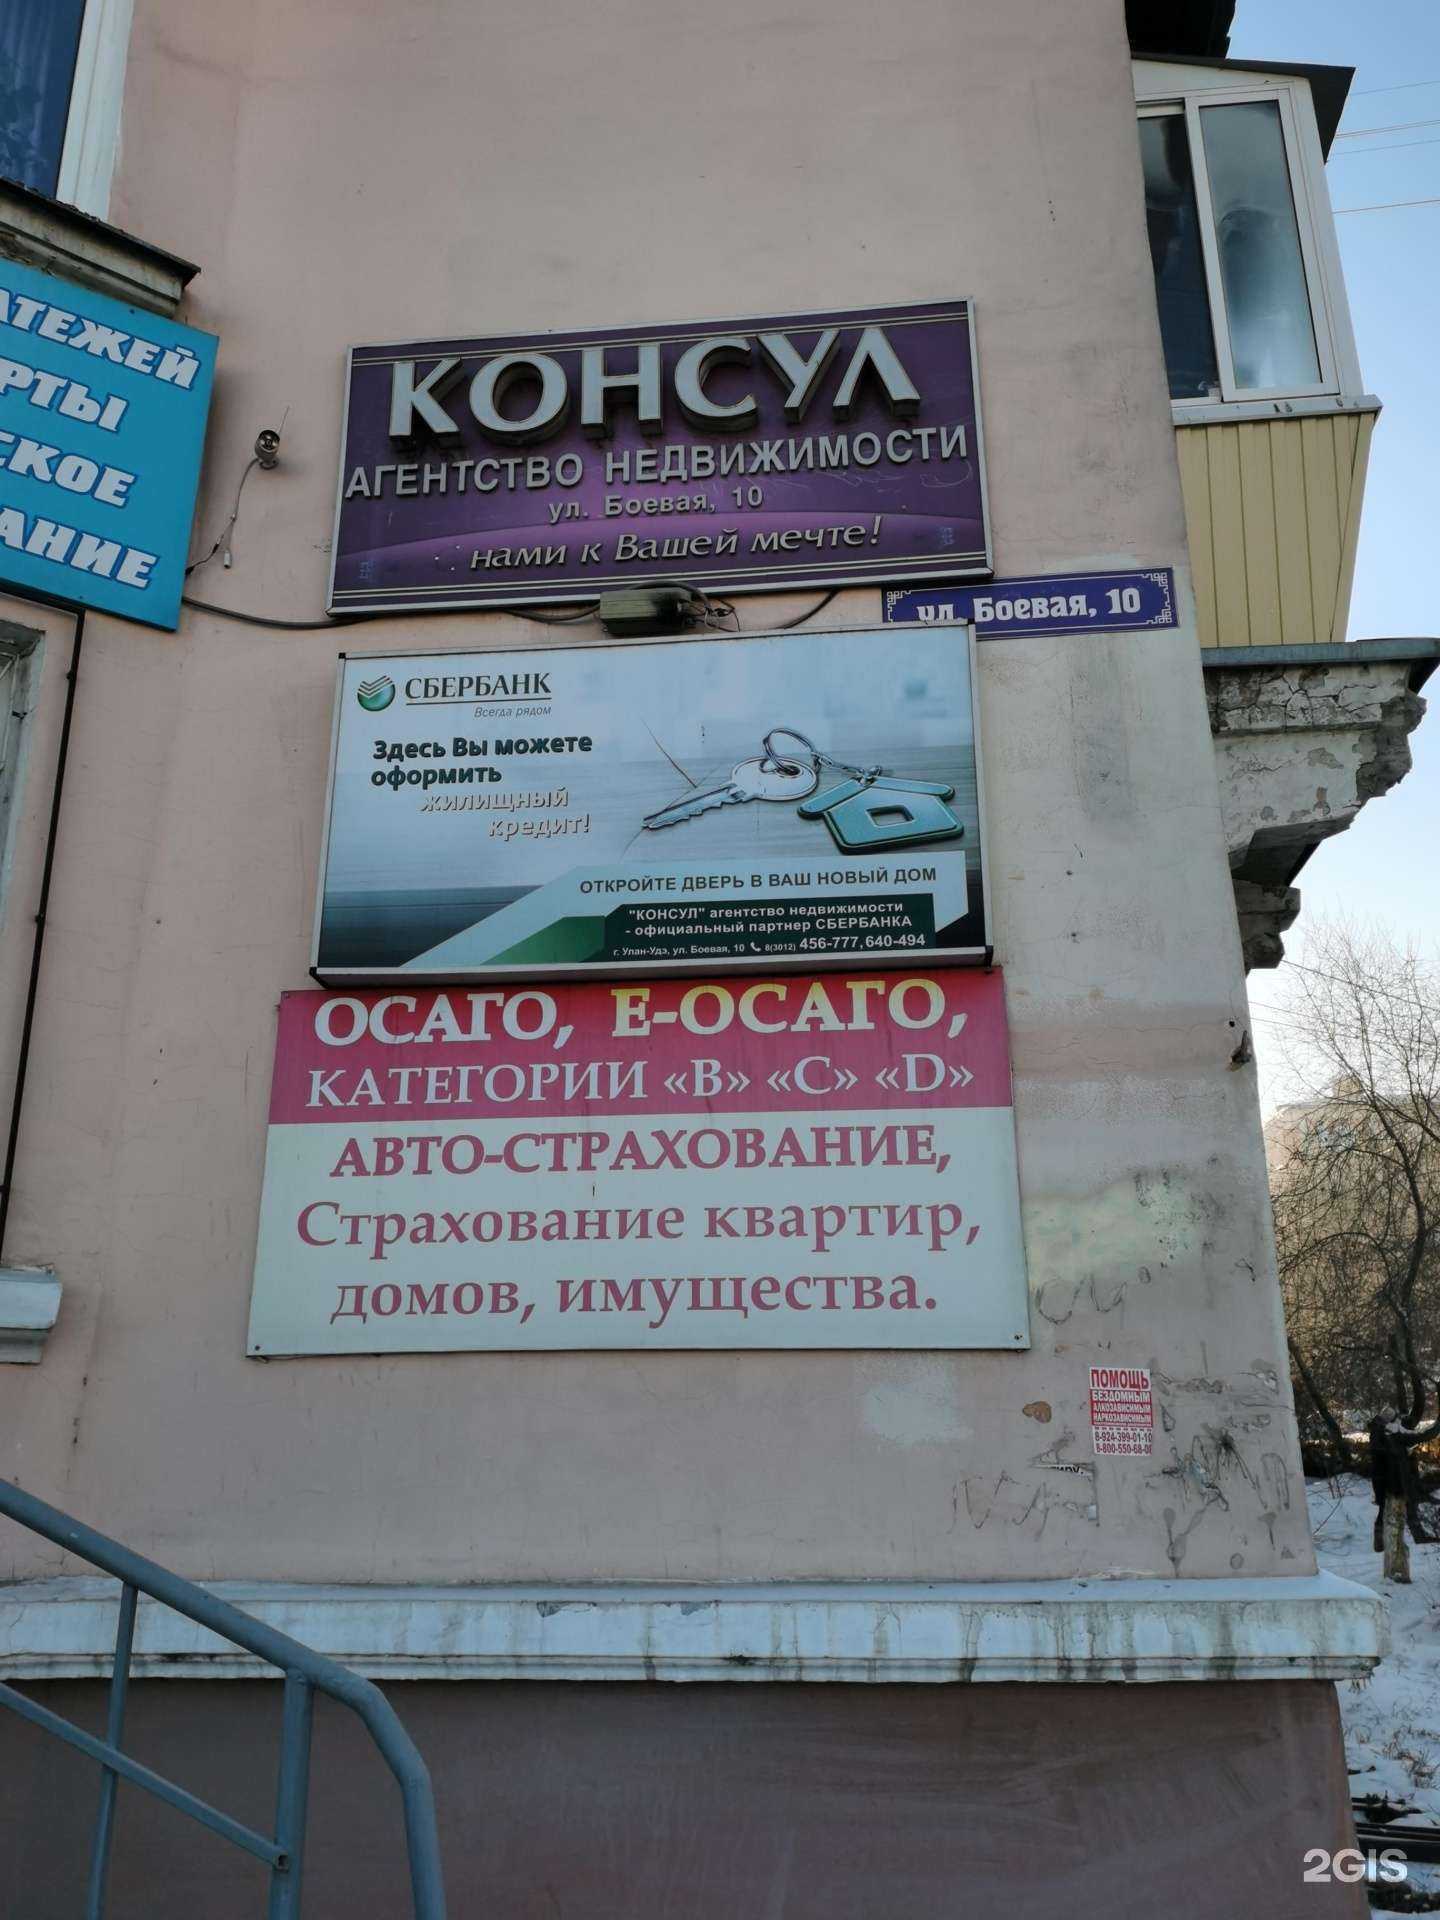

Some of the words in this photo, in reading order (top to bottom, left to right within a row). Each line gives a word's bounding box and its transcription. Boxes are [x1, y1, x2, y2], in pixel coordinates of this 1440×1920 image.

[388, 326, 921, 438] КОНСУЛ
[345, 452, 584, 500] АГЕНТСТВО
[605, 425, 968, 485] НЕДВИЖИМОСТИ
[548, 501, 588, 524] ул.
[604, 491, 717, 517] Боевая,
[732, 486, 763, 509] 10
[470, 543, 568, 570] нами
[580, 541, 602, 563] к
[614, 528, 738, 562] Вашей
[750, 515, 883, 553] мечте!
[973, 594, 1097, 622] Боевая,
[1105, 587, 1141, 614] 10
[405, 672, 552, 699] СБЕРБАНК
[474, 706, 513, 718] Всегда
[515, 705, 552, 718] рядом
[373, 740, 447, 762] Здесь
[452, 737, 488, 758] Вы
[494, 734, 592, 756] можете
[371, 766, 502, 791] оформить
[420, 786, 569, 813] жилищный
[488, 814, 592, 842] кредит!
[580, 875, 677, 893] ОТКРОЙТЕ
[681, 875, 745, 892] ДВЕРЬ
[751, 875, 763, 888] В
[768, 872, 811, 887] ВАШ
[817, 866, 888, 885] НОВЫЙ
[894, 867, 937, 884] ДОМ
[628, 907, 706, 921] "КОНСУЛ"
[709, 907, 785, 919] агентство
[789, 902, 903, 917] недвижимости
[634, 921, 745, 938] официальный
[749, 919, 812, 934] партнер
[815, 915, 913, 930] СБЕРБАНКА
[622, 946, 671, 957] Улан-Удэ,
[672, 946, 688, 956] ул.
[690, 944, 731, 954] Боевая,
[734, 943, 746, 953] 10
[764, 943, 797, 952] 8(3012)
[313, 990, 574, 1049] ОСАГО,
[611, 977, 969, 1040] Е-ОСАГО,
[306, 1060, 649, 1108] КАТЕГОРИИ
[875, 1052, 975, 1093] «D»
[329, 1124, 952, 1178] АВТО-СТРАХОВАНИЕ,
[297, 1200, 686, 1260] Страхование
[704, 1200, 982, 1253] квартир,
[331, 1277, 536, 1325] домов,
[556, 1274, 937, 1328] имущества.
[1091, 1369, 1149, 1390] ПОМОЩЬ
[1092, 1390, 1151, 1403] БЕЗДОМНЫМ
